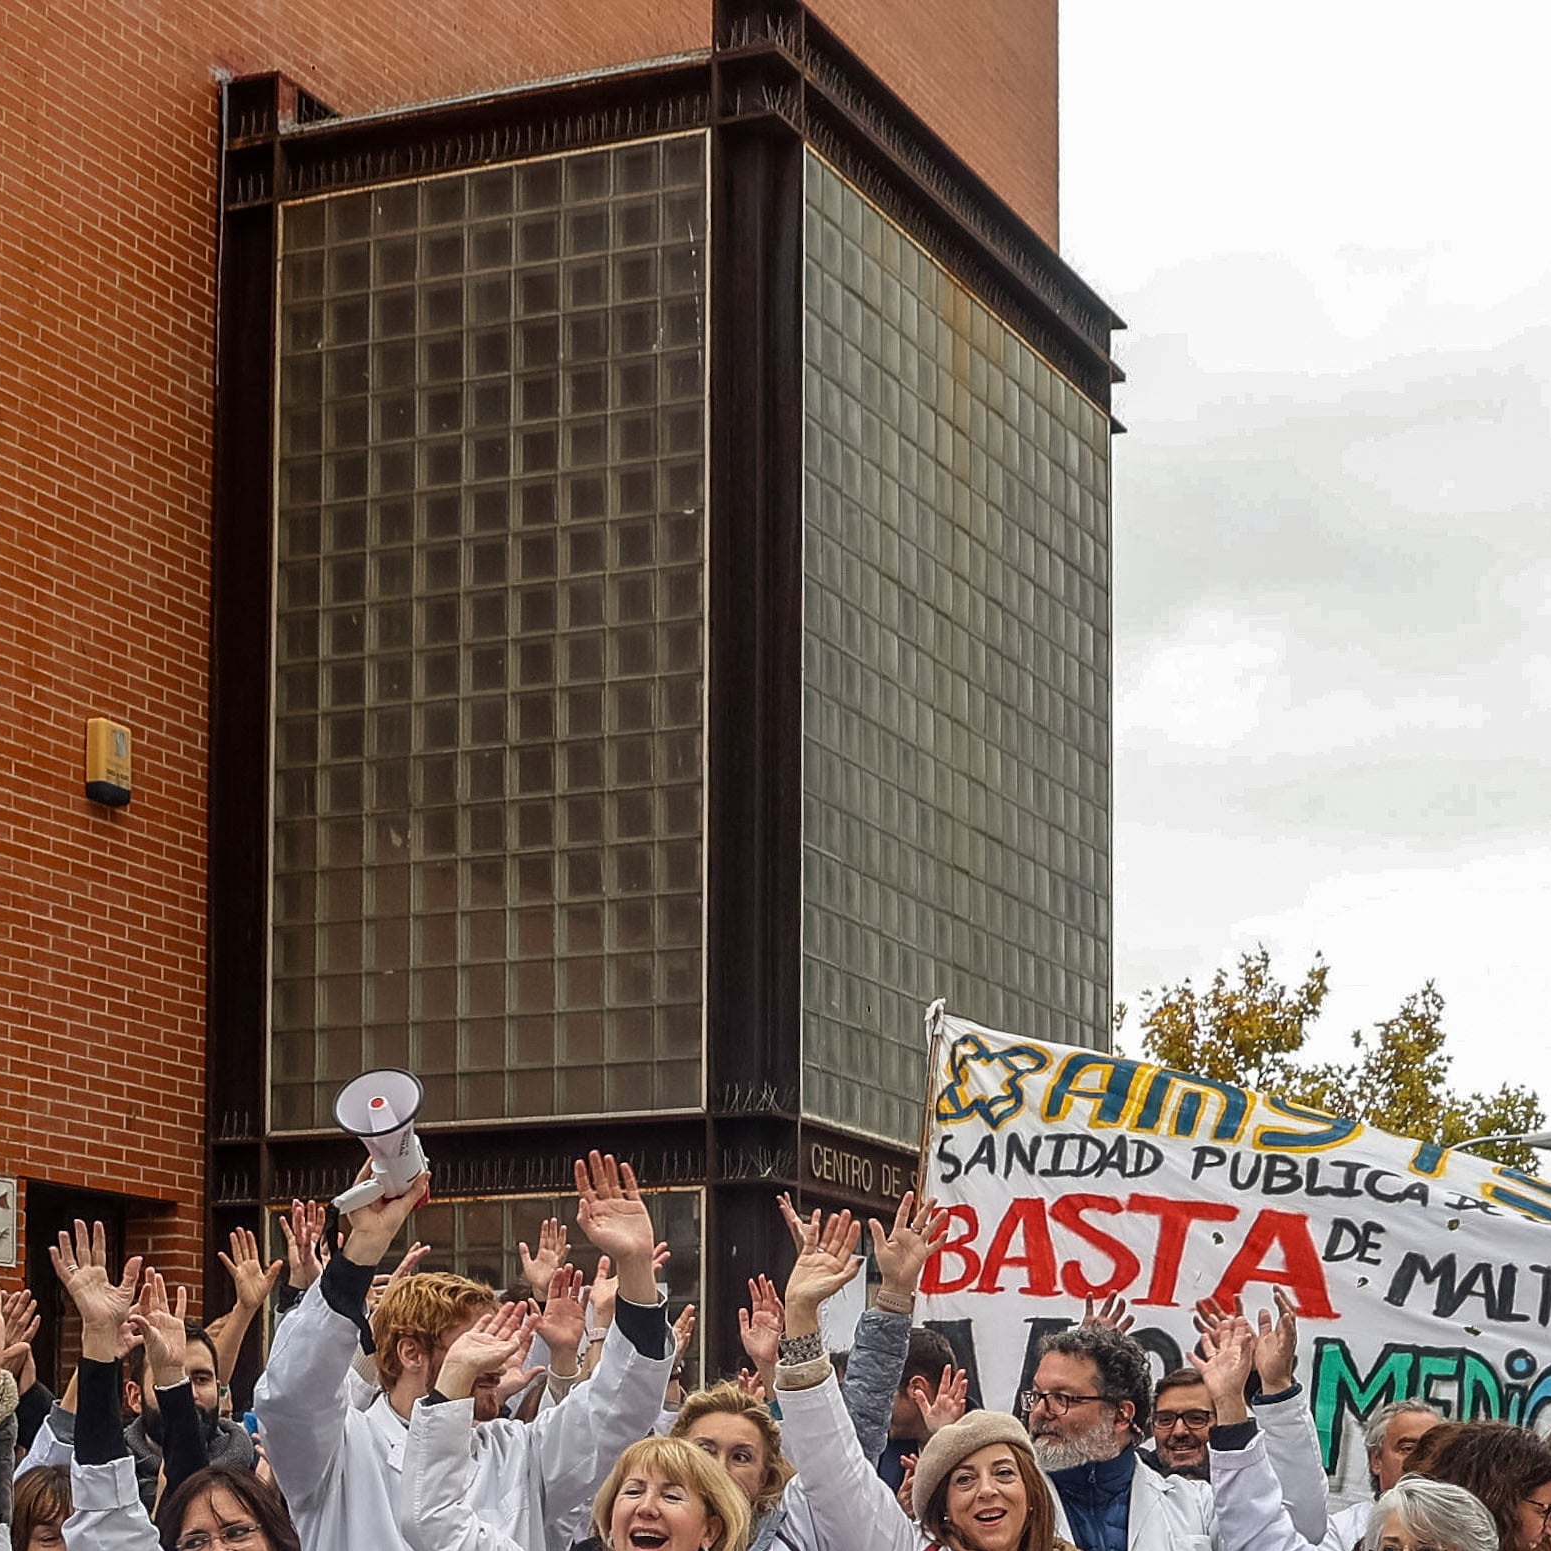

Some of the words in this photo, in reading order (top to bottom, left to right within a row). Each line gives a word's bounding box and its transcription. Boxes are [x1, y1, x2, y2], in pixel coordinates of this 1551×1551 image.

[811, 1143, 873, 1193] CENTRO
[881, 1163, 902, 1198] DE
[936, 1132, 1165, 1184] SANIDAD
[1190, 1145, 1429, 1209] PUBLICA
[919, 1192, 1341, 1320] BASTA
[1322, 1218, 1386, 1267] DE
